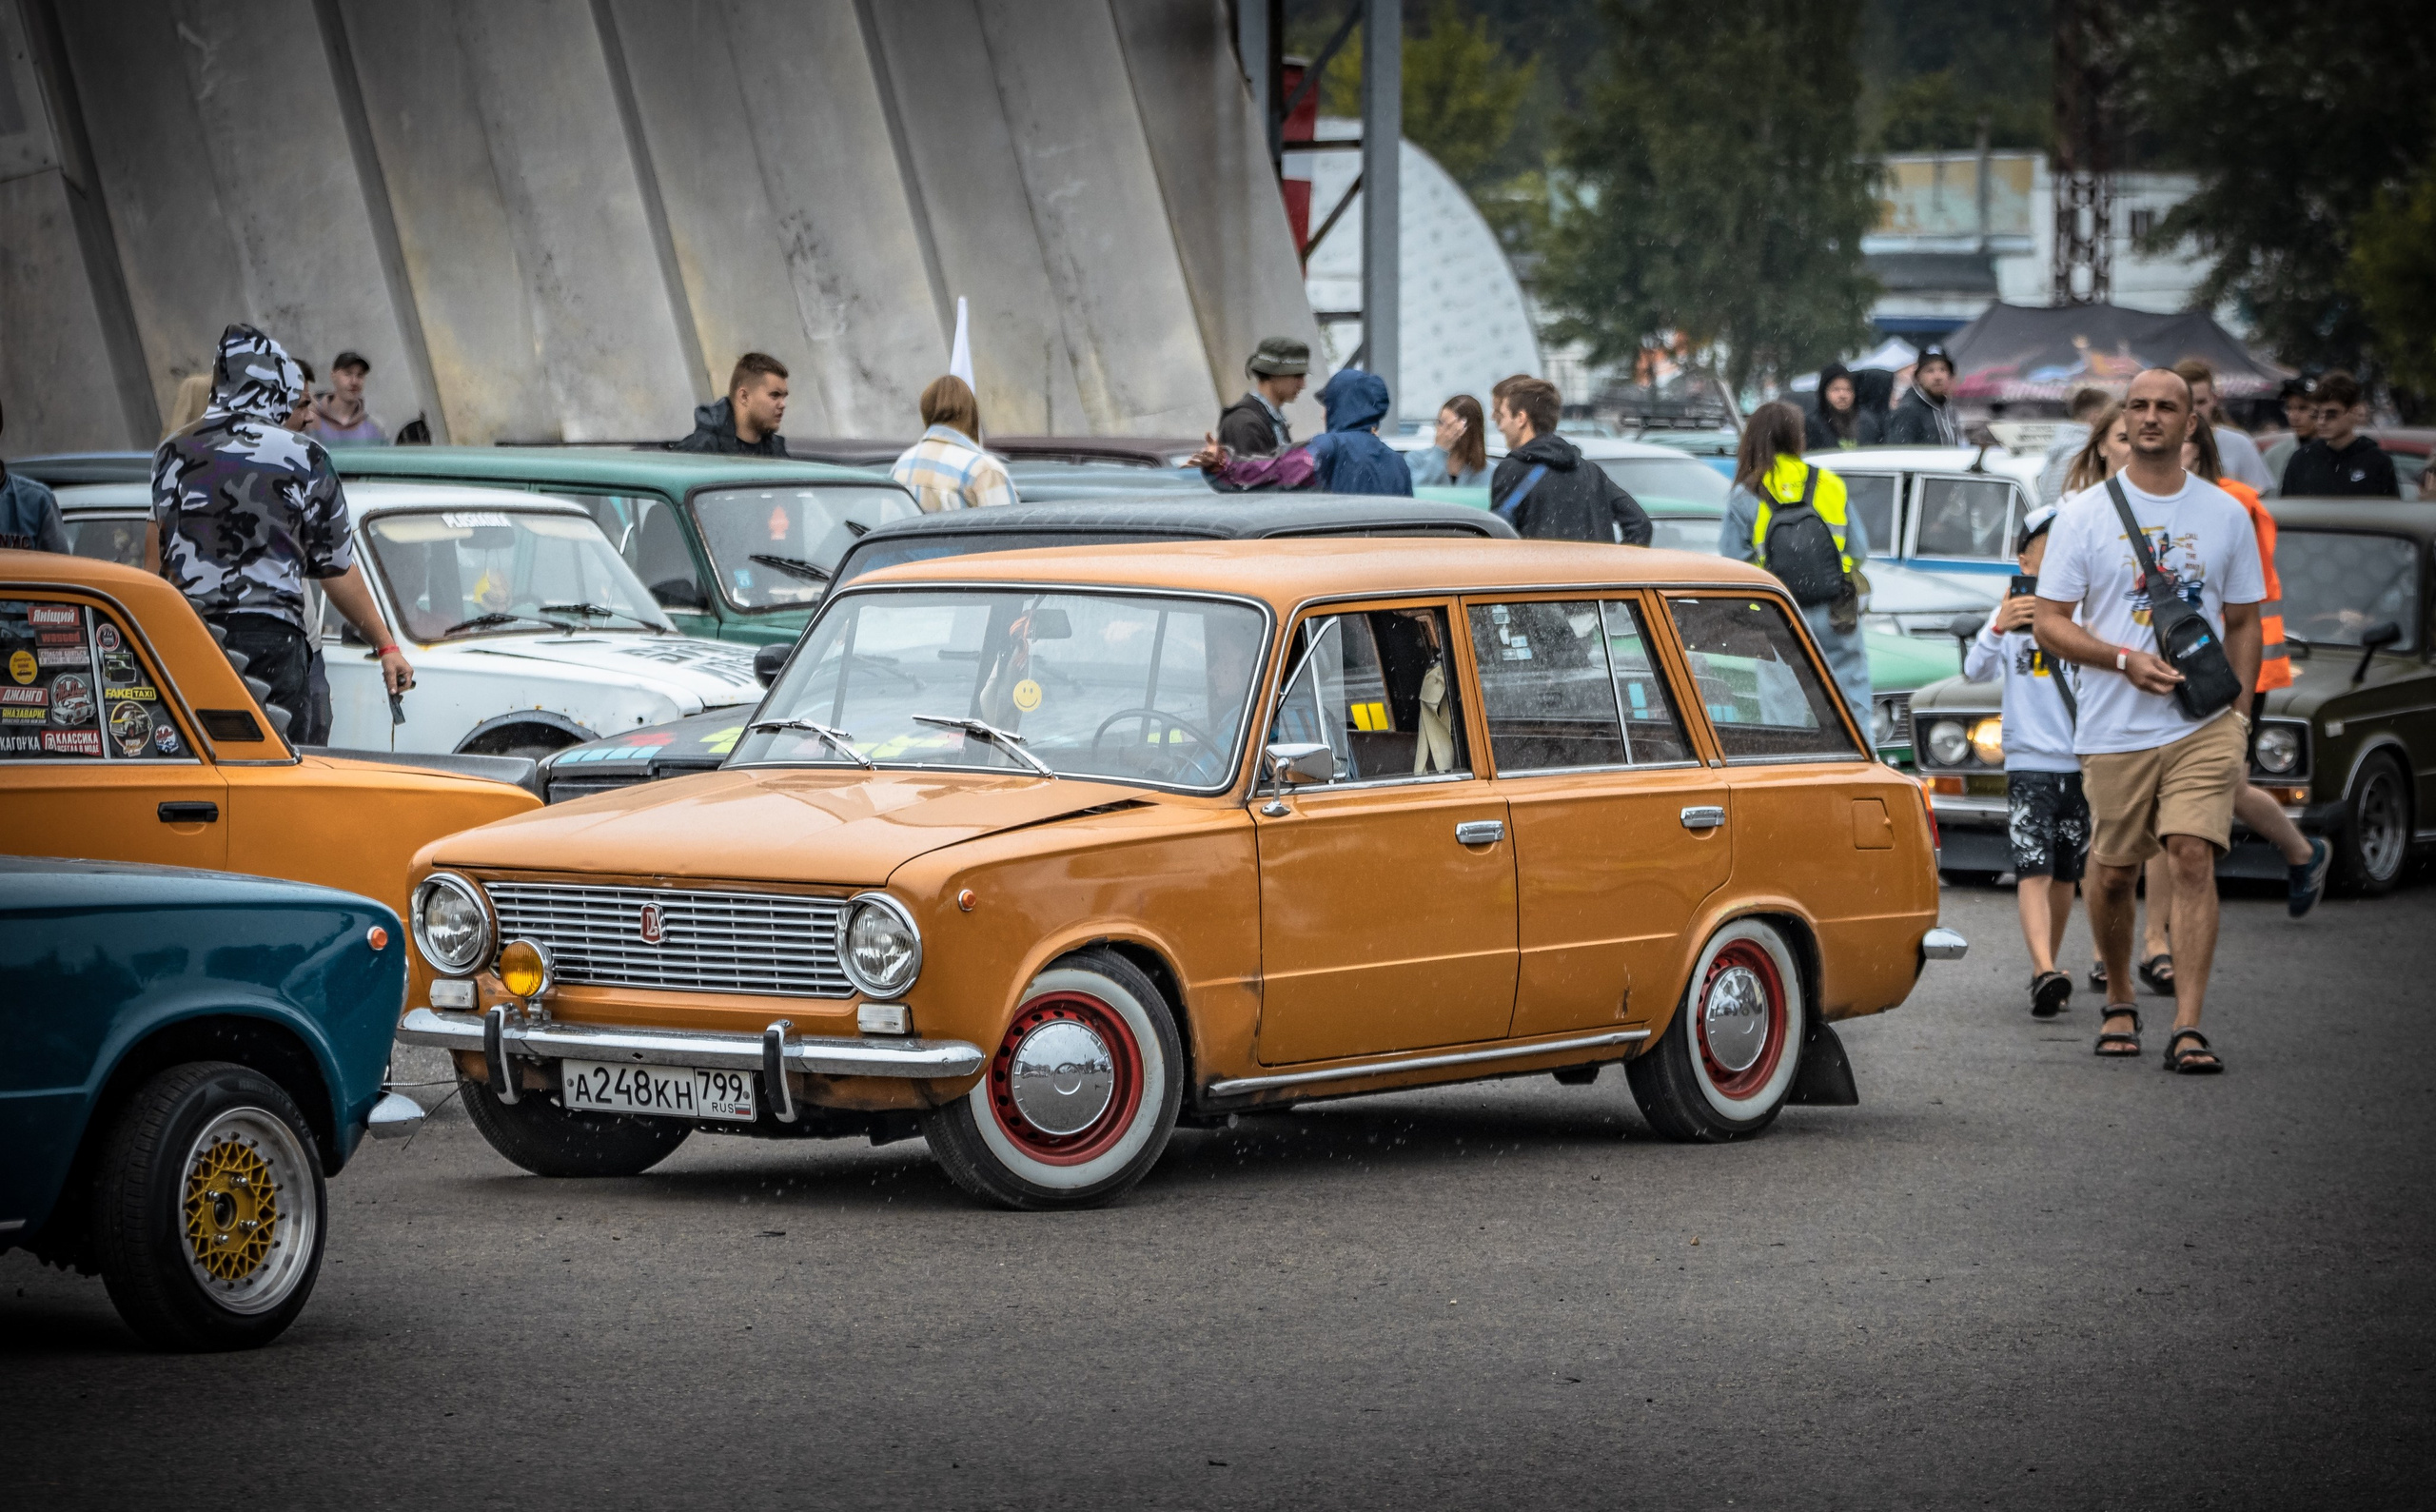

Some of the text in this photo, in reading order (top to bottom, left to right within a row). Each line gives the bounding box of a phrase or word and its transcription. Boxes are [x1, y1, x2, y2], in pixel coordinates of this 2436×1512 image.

[2, 689, 43, 702] ДЖАНГО
[105, 687, 131, 699] FAKE
[56, 732, 98, 744] КЛАССИКА
[576, 1067, 743, 1109] А248КН 799
[712, 1102, 734, 1113] RUS
